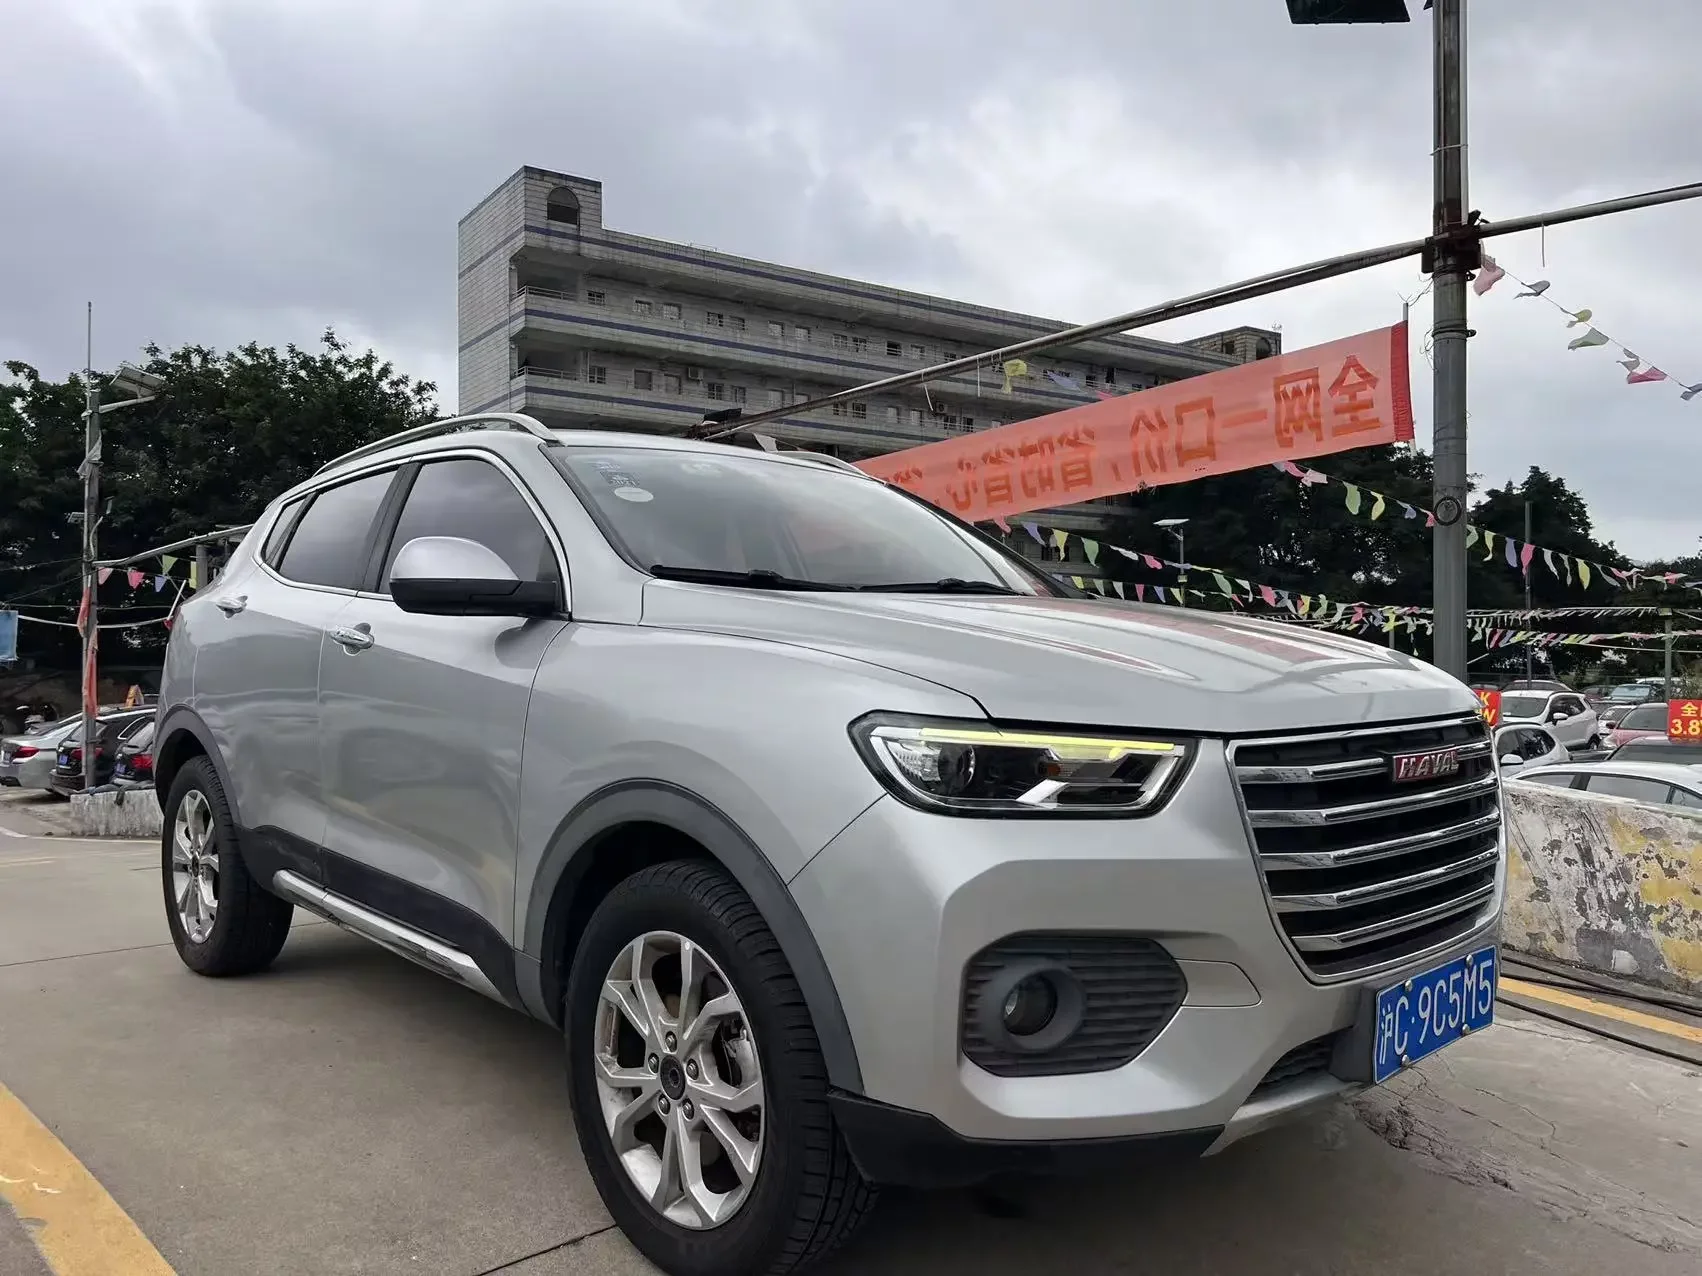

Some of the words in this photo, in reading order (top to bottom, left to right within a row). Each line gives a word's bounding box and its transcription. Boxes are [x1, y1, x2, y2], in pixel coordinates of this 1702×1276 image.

[1680, 701, 1702, 717] 全
[1671, 718, 1702, 736] 3.8
[1398, 751, 1460, 779] HAVAL
